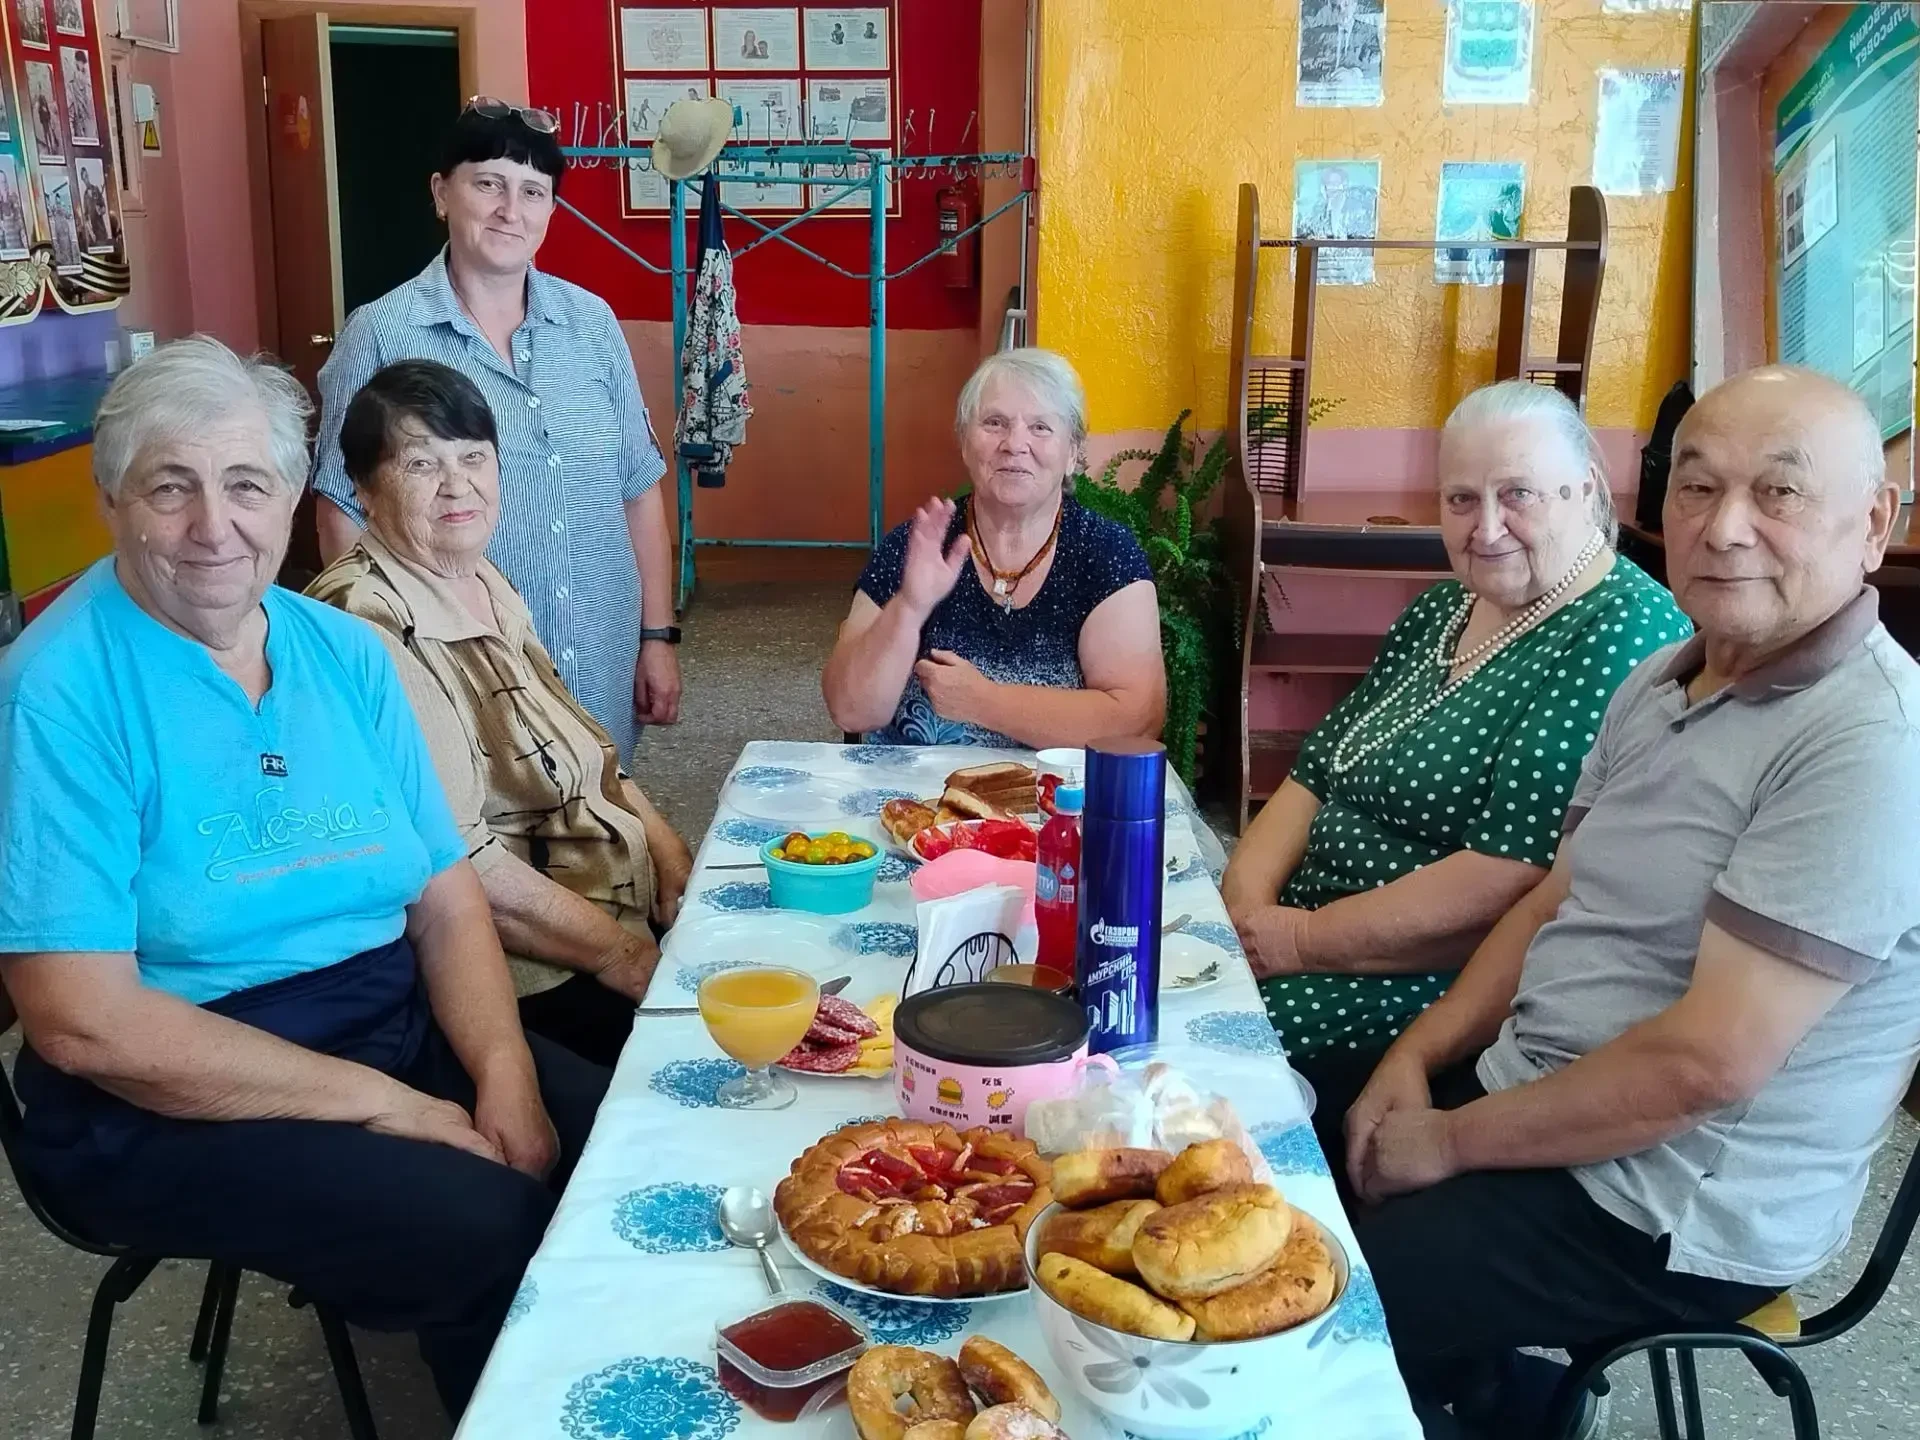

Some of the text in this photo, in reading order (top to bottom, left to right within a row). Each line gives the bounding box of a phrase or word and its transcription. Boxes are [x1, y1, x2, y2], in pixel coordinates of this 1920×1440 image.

[197, 785, 372, 862] Alessia
[1105, 925, 1139, 937] ГАЗПРОМ
[1087, 952, 1132, 985] АМУРСКИЙ
